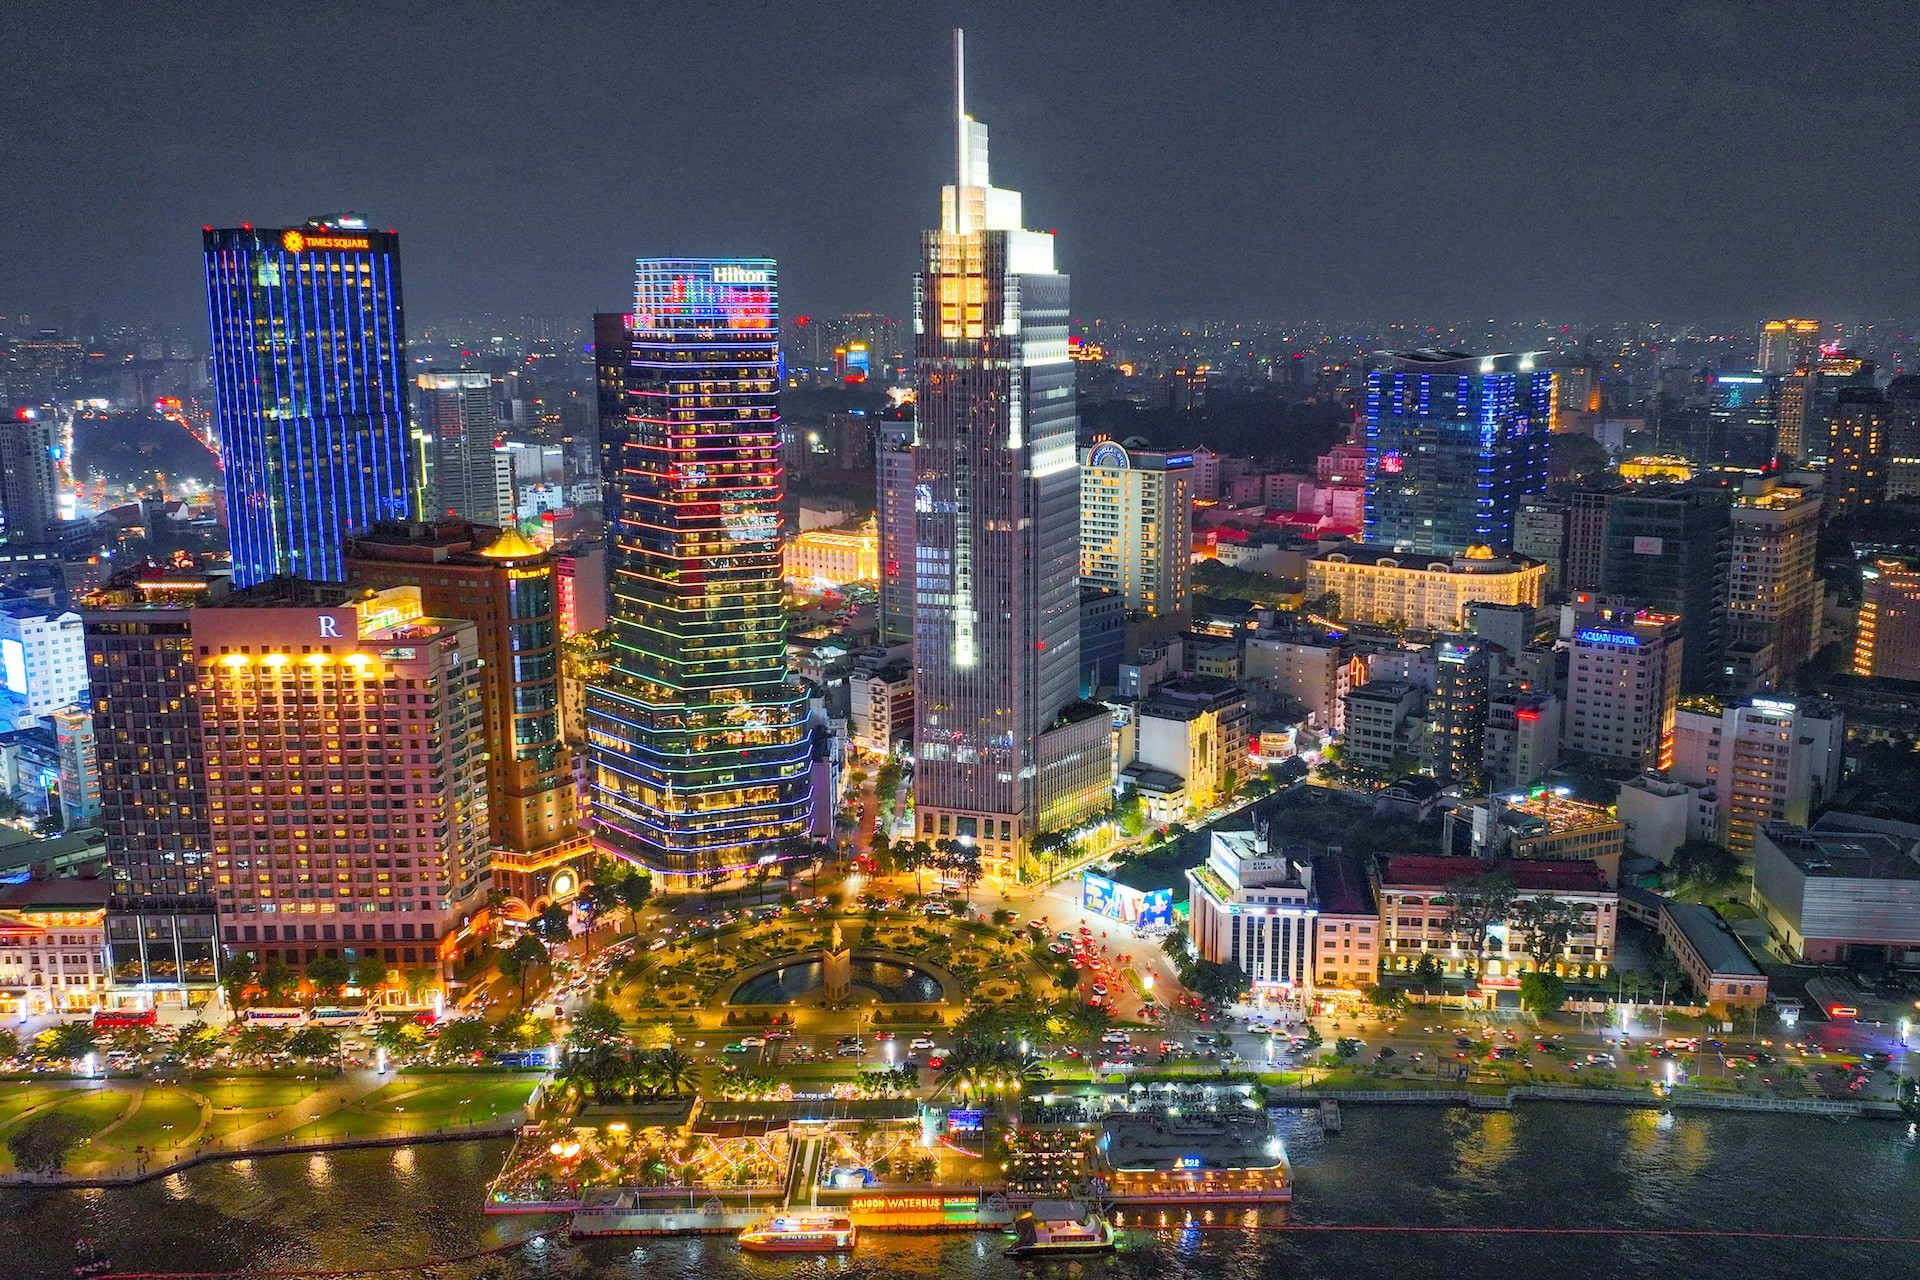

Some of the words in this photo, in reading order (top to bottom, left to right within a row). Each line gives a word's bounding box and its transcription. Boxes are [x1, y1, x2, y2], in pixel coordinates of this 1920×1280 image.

[305, 237, 332, 247] TIMES
[333, 238, 369, 249] SQUARE
[713, 265, 767, 283] Hilton
[318, 615, 342, 638] R
[1612, 634, 1637, 646] HOTEL
[452, 652, 460, 665] R
[1752, 698, 1797, 711] SILVERLAND
[852, 1199, 885, 1209] SAIGON
[888, 1198, 940, 1208] WATERBUS
